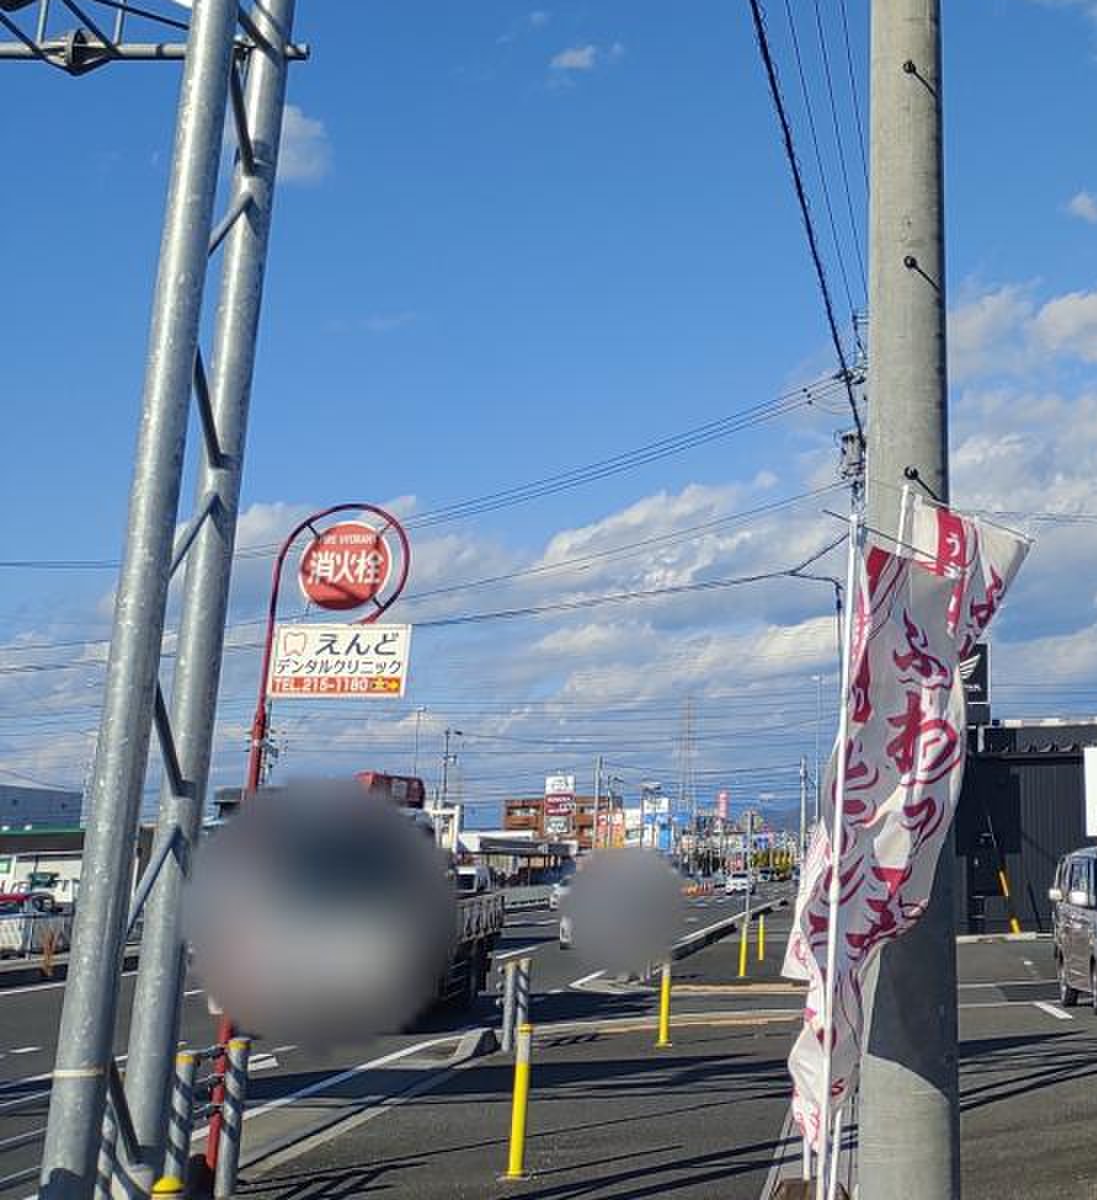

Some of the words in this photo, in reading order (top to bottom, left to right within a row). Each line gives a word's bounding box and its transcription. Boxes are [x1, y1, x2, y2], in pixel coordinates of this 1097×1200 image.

[307, 551, 384, 585] 消火栓
[314, 632, 400, 656] えんど
[275, 657, 401, 675] デンタルクリニック
